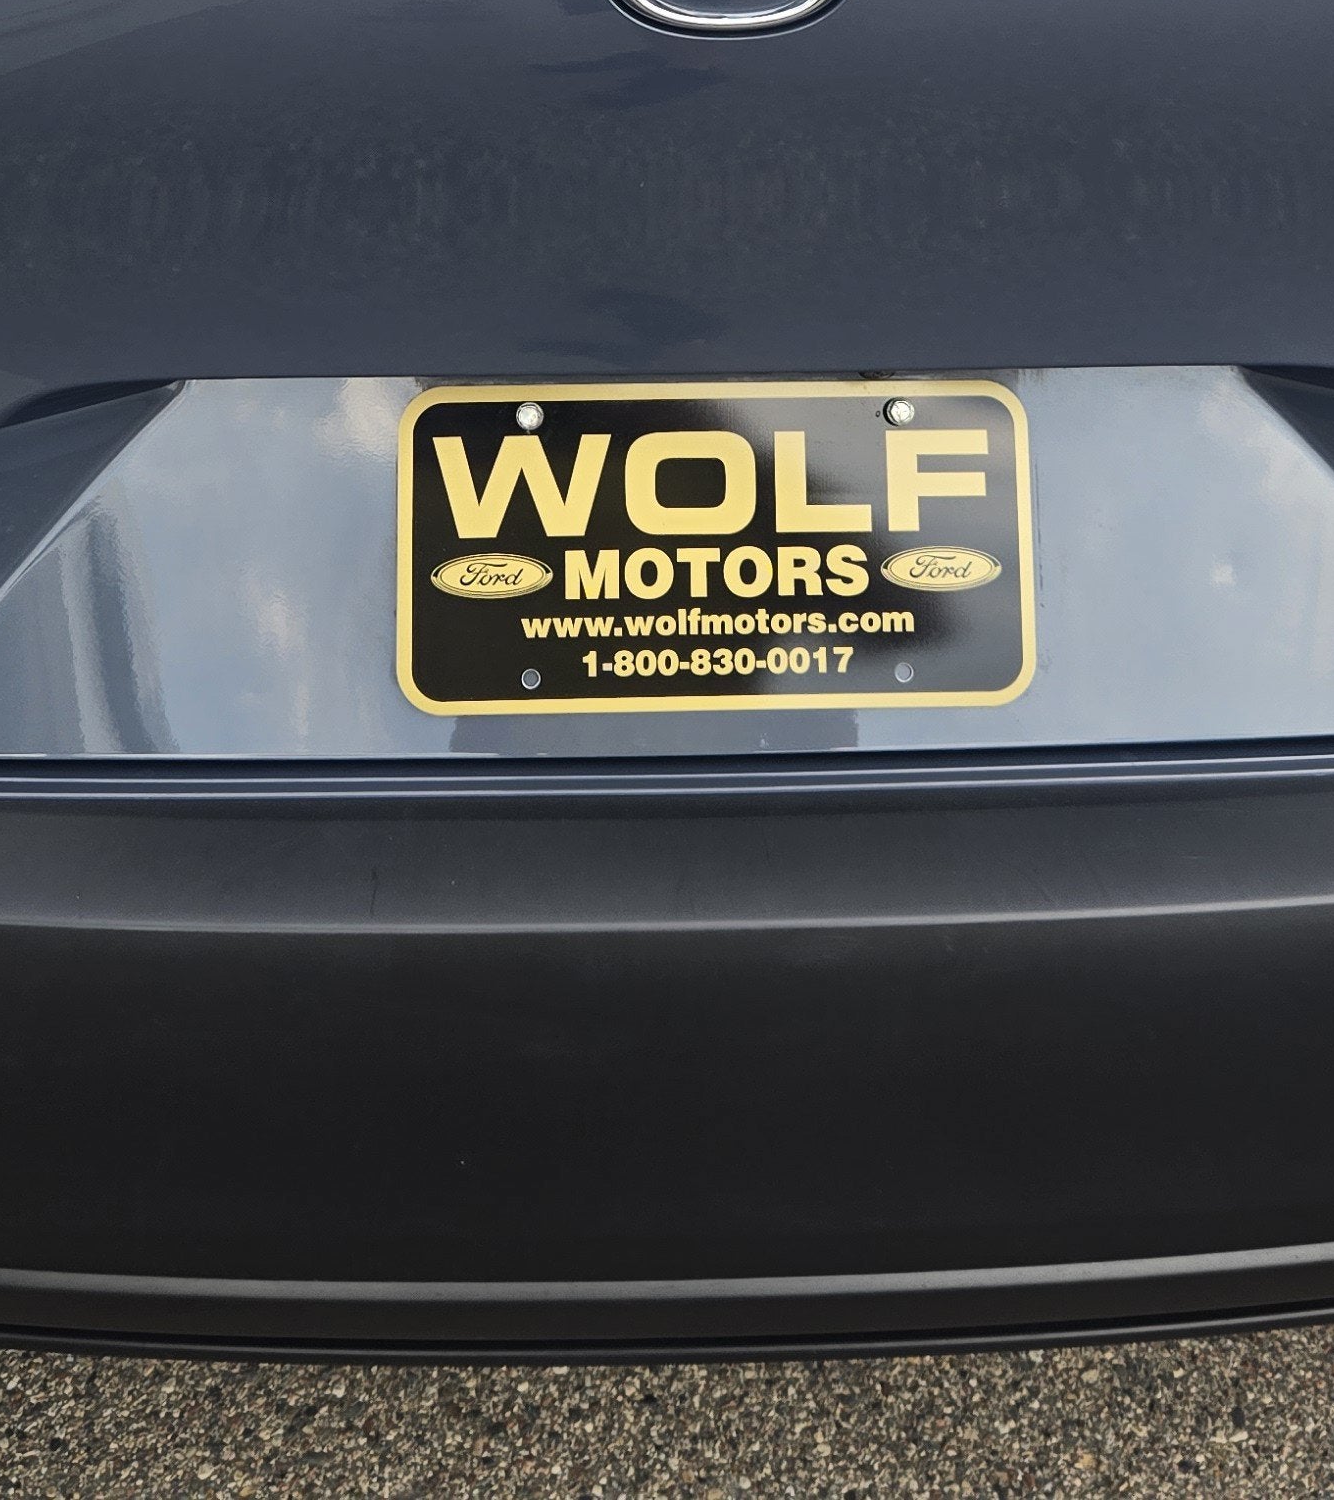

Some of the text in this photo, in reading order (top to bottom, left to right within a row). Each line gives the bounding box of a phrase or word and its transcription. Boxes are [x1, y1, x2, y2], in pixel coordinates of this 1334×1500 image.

[431, 428, 991, 539] WOLF
[458, 556, 525, 587] Ford
[563, 544, 870, 600] MOTORS
[905, 553, 973, 581] Ford
[521, 606, 915, 639] www.wolfmotors.com
[581, 647, 855, 678] 1-800-830-0017
